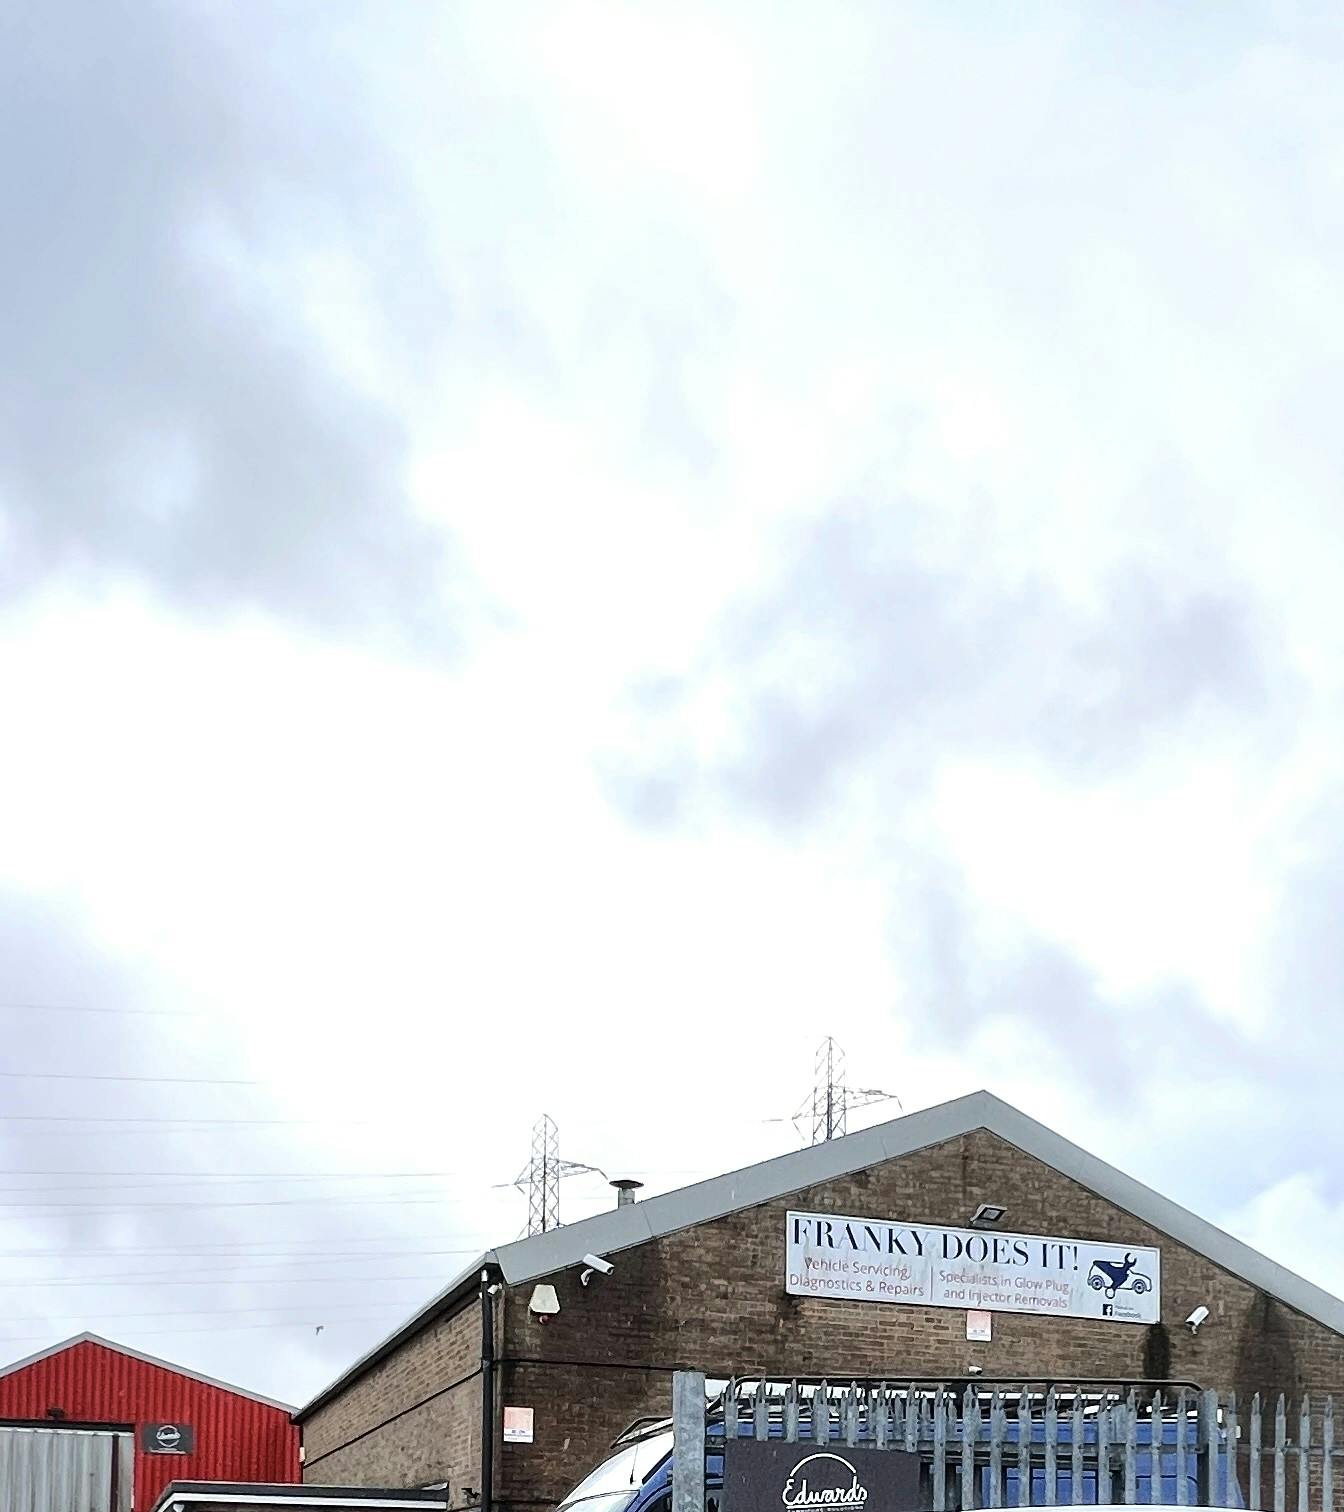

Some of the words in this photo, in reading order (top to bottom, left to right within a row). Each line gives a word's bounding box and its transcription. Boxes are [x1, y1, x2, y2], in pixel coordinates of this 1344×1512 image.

[794, 1218, 930, 1257] FRANKY
[942, 1233, 1029, 1267] DOES
[1041, 1243, 1079, 1271] IT!
[804, 1256, 850, 1272] Vehicle
[789, 1273, 862, 1292] Diagnostics
[865, 1279, 875, 1293] &
[879, 1281, 924, 1297] Repairs
[939, 1269, 998, 1287] Specialists
[1000, 1275, 1012, 1287] in
[1014, 1277, 1043, 1290] Glow
[943, 1288, 965, 1300] and
[968, 1289, 1013, 1304] Injector
[1014, 1293, 1068, 1308] Removals
